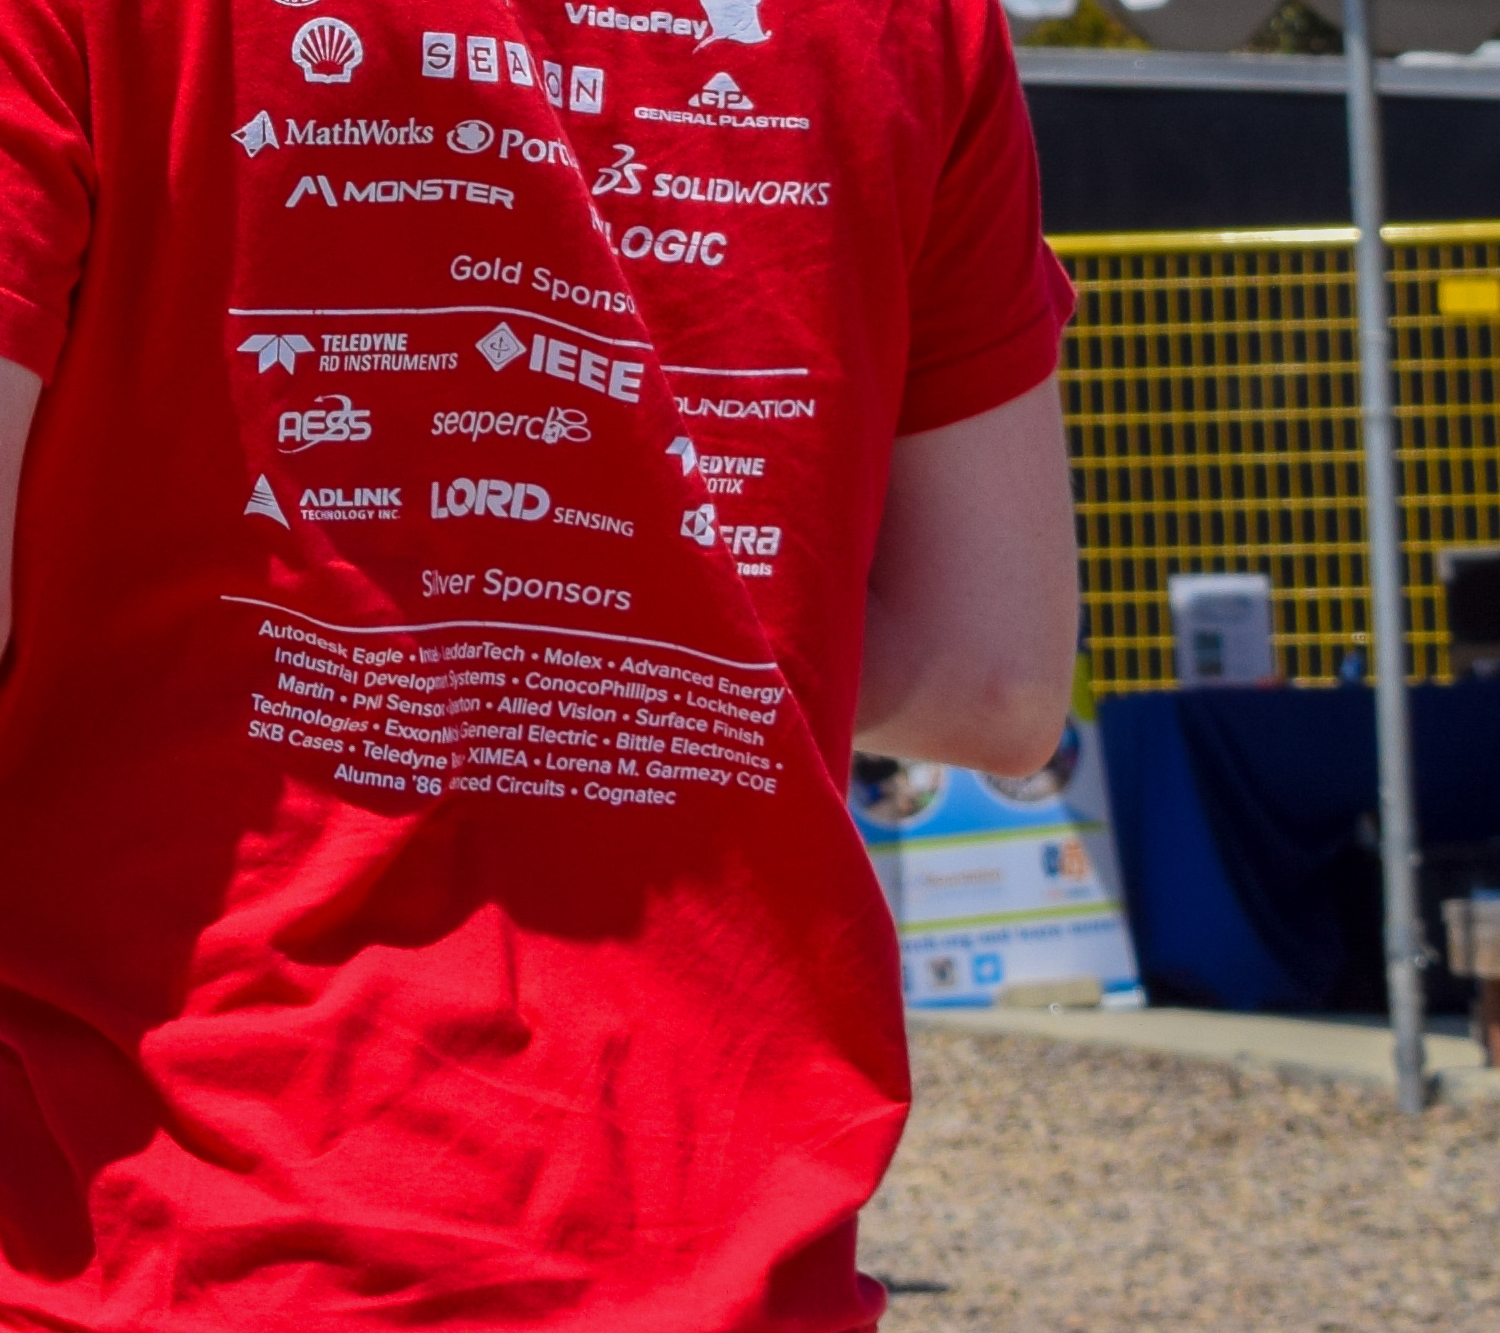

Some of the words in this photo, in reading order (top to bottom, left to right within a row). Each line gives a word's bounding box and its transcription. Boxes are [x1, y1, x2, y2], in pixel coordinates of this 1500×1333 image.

[565, 2, 707, 40] VideoRay
[284, 117, 434, 146] MathWorks
[634, 105, 716, 127] GENERAL
[719, 115, 810, 130] PLASTICS
[343, 178, 515, 210] MONSTER
[652, 173, 831, 206] SOLIDWORKS
[450, 254, 523, 284] Gold
[531, 267, 637, 315] Sponso
[319, 354, 341, 372] RD
[344, 352, 458, 372] INSTRUMENTS
[321, 333, 408, 353] TELEDYNE
[528, 333, 645, 404] IEEE
[699, 455, 765, 478] EDYNE
[300, 487, 403, 507] ADLINK
[707, 478, 744, 495] OTIX
[300, 509, 374, 521] TECHNOLOGY
[430, 477, 551, 521] LORD
[553, 507, 635, 538] SENSING
[421, 569, 476, 598] Silver
[482, 567, 632, 611] Sponsors
[258, 619, 348, 659] Autodesk
[352, 647, 403, 667] Eagle
[544, 646, 603, 670] Molex
[619, 655, 715, 689] Advanced
[717, 677, 786, 706] Energy
[274, 646, 358, 685] Industrial
[686, 690, 777, 725] Lockheed
[277, 672, 335, 702] Martin
[352, 692, 383, 711] PNI
[497, 696, 553, 718] Allied
[558, 700, 617, 723] Vision
[635, 707, 708, 733] Surface
[712, 719, 765, 747] Finish
[251, 692, 369, 733] Technologies
[460, 720, 524, 741] General
[527, 724, 598, 748] Electric
[616, 731, 665, 754] Bittle
[669, 736, 770, 771] Electronics
[248, 719, 285, 742] SKB
[288, 728, 344, 754] Cases
[361, 739, 448, 770] Teledyne
[467, 746, 529, 769] XIMEA
[546, 752, 612, 775] Lorena
[616, 756, 640, 778] M.
[645, 759, 732, 786] Garmezy
[736, 770, 778, 795] COE
[334, 763, 406, 792] Alumna
[411, 774, 443, 797] '86
[496, 774, 566, 799] Circuits
[583, 781, 677, 806] Cognatec
